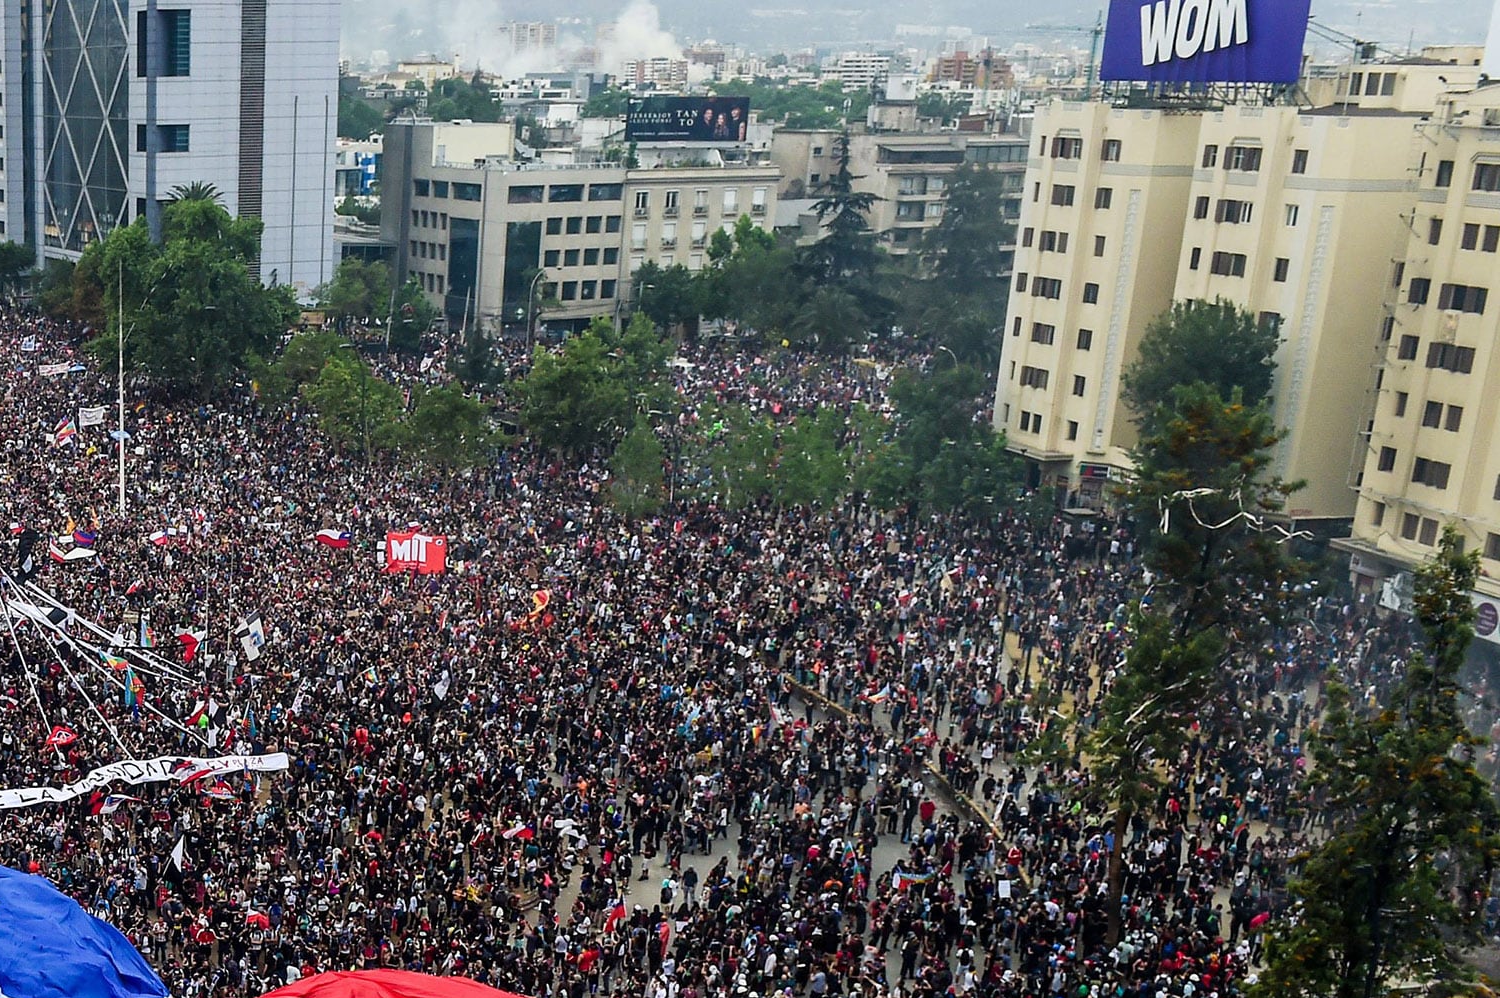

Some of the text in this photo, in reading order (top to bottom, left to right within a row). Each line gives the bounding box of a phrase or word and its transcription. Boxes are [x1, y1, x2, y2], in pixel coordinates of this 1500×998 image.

[1140, 0, 1249, 66] WOM
[390, 533, 433, 563] MIT
[15, 788, 54, 803] LA
